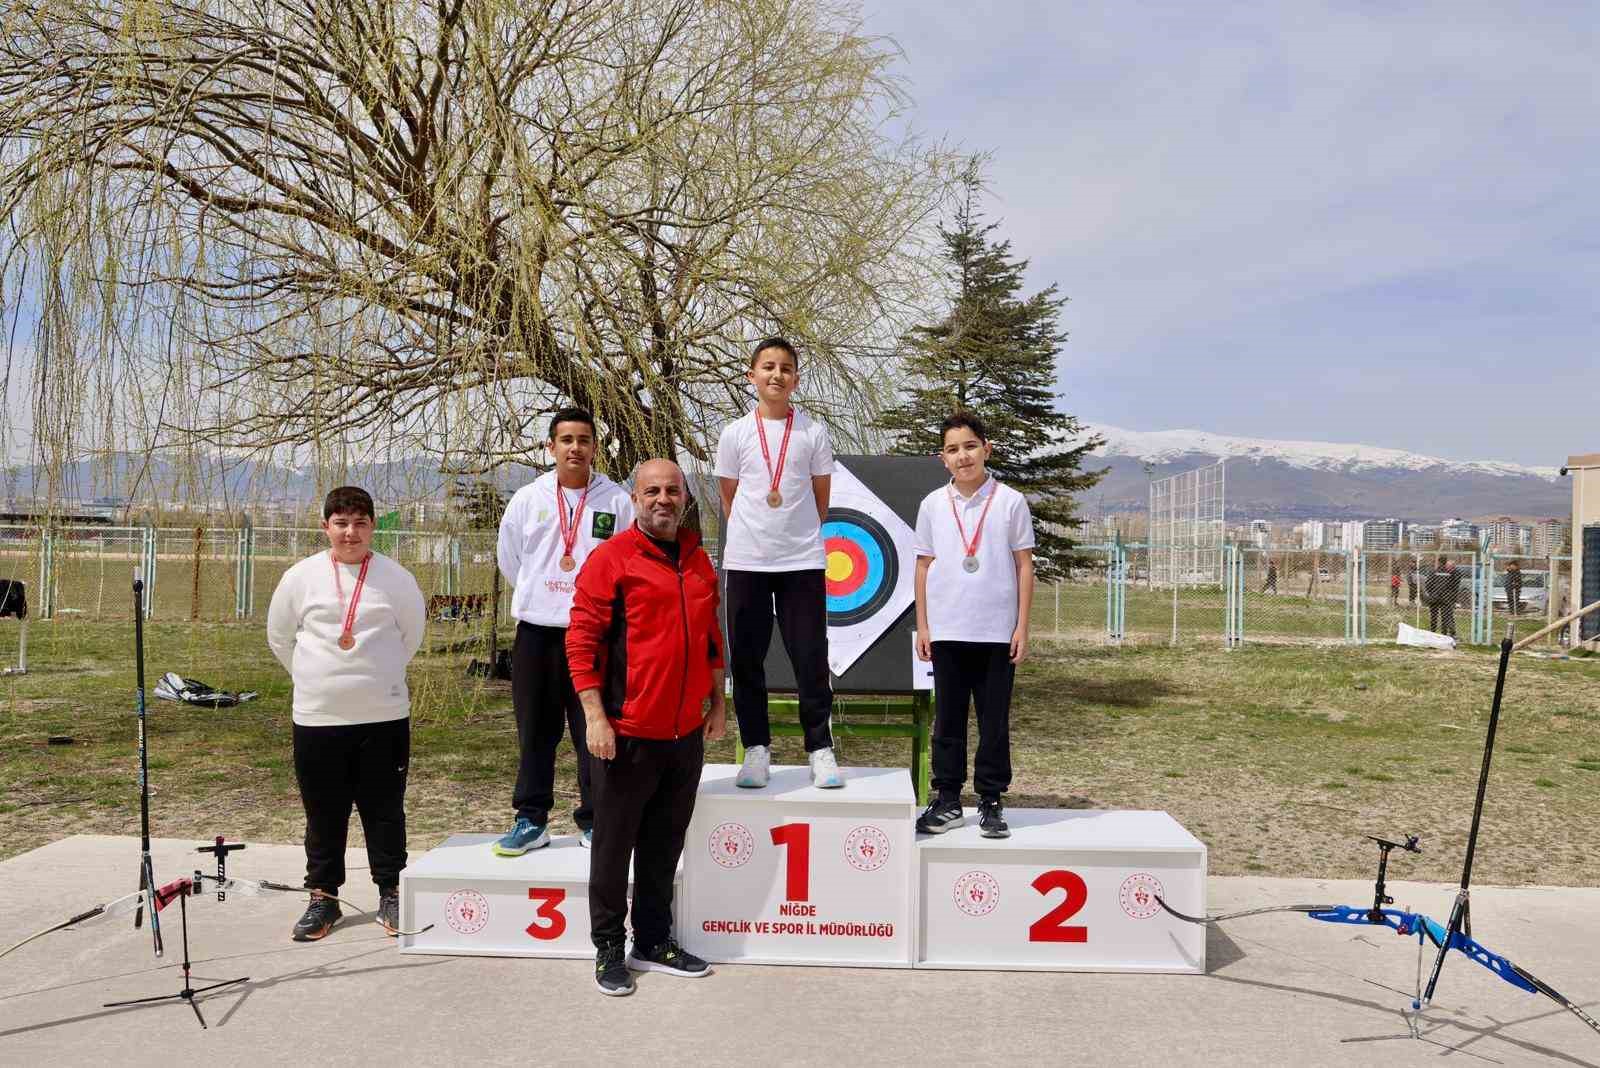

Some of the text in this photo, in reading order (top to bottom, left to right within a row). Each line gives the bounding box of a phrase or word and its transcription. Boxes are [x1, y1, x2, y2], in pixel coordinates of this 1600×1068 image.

[769, 823, 810, 901] 1
[525, 887, 567, 941] 3
[702, 920, 894, 937] GENÇLİK VE SPOR İL MÜDÜRLÜĞÜ
[779, 902, 817, 916] NİĞDE
[1028, 869, 1088, 943] 2
